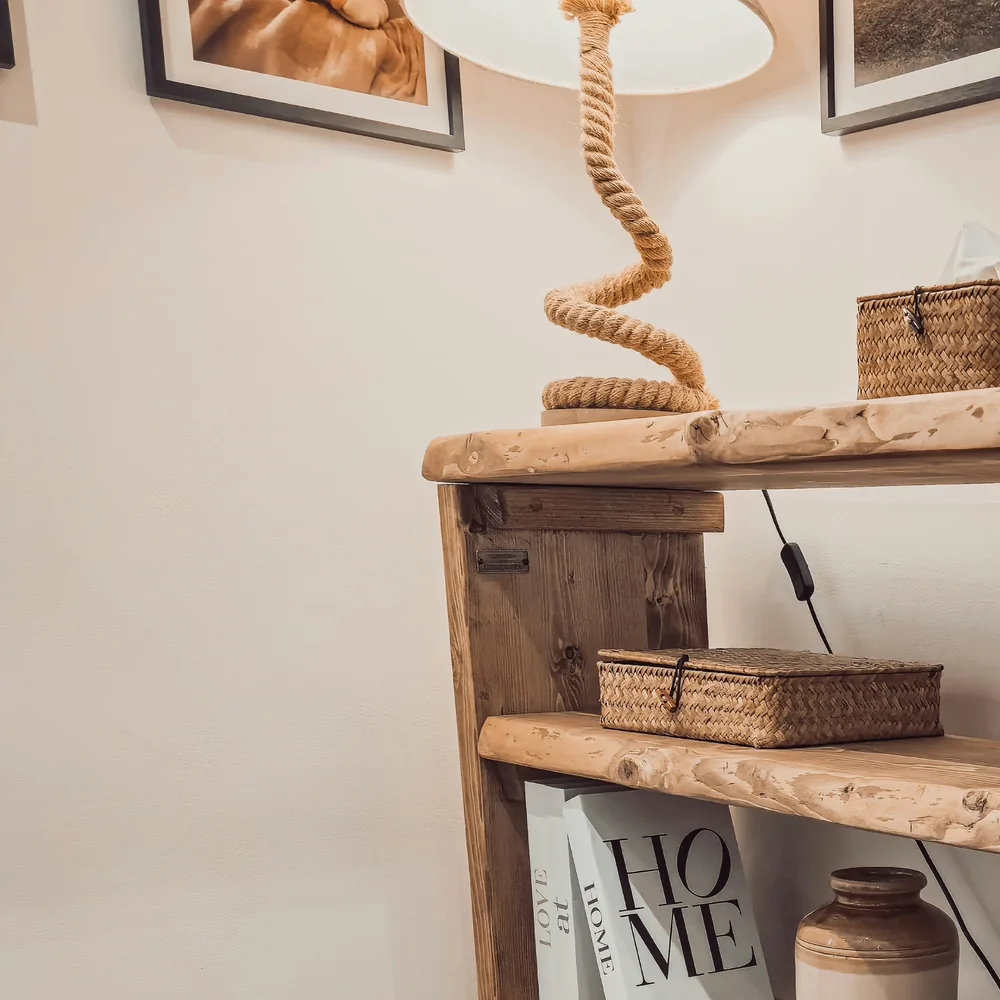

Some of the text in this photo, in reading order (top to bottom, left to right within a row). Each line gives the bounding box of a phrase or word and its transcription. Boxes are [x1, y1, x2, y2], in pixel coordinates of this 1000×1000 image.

[534, 868, 552, 948] LOVE
[602, 827, 731, 912] HO
[553, 898, 570, 934] at
[583, 880, 615, 975] HOME
[620, 898, 757, 987] ME
